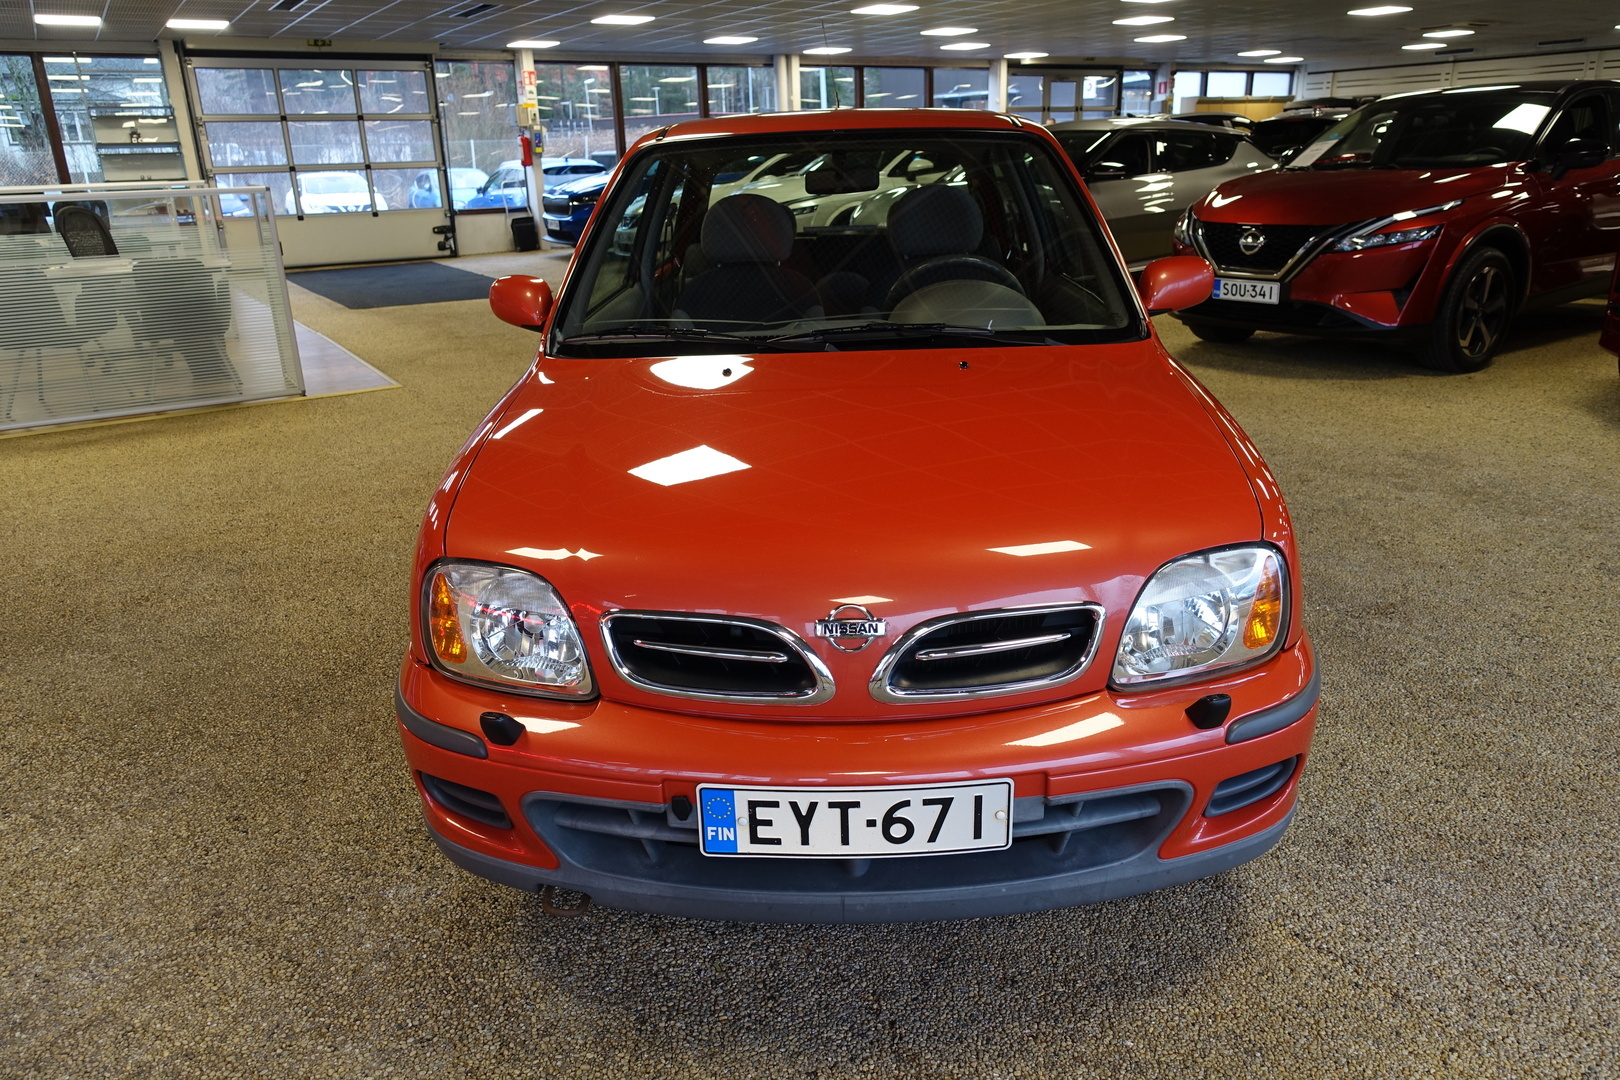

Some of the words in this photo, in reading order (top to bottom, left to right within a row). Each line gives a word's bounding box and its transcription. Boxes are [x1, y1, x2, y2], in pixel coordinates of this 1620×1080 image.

[823, 623, 879, 635] NISSAN
[707, 826, 735, 842] FIN
[747, 794, 983, 846] EYT-671
